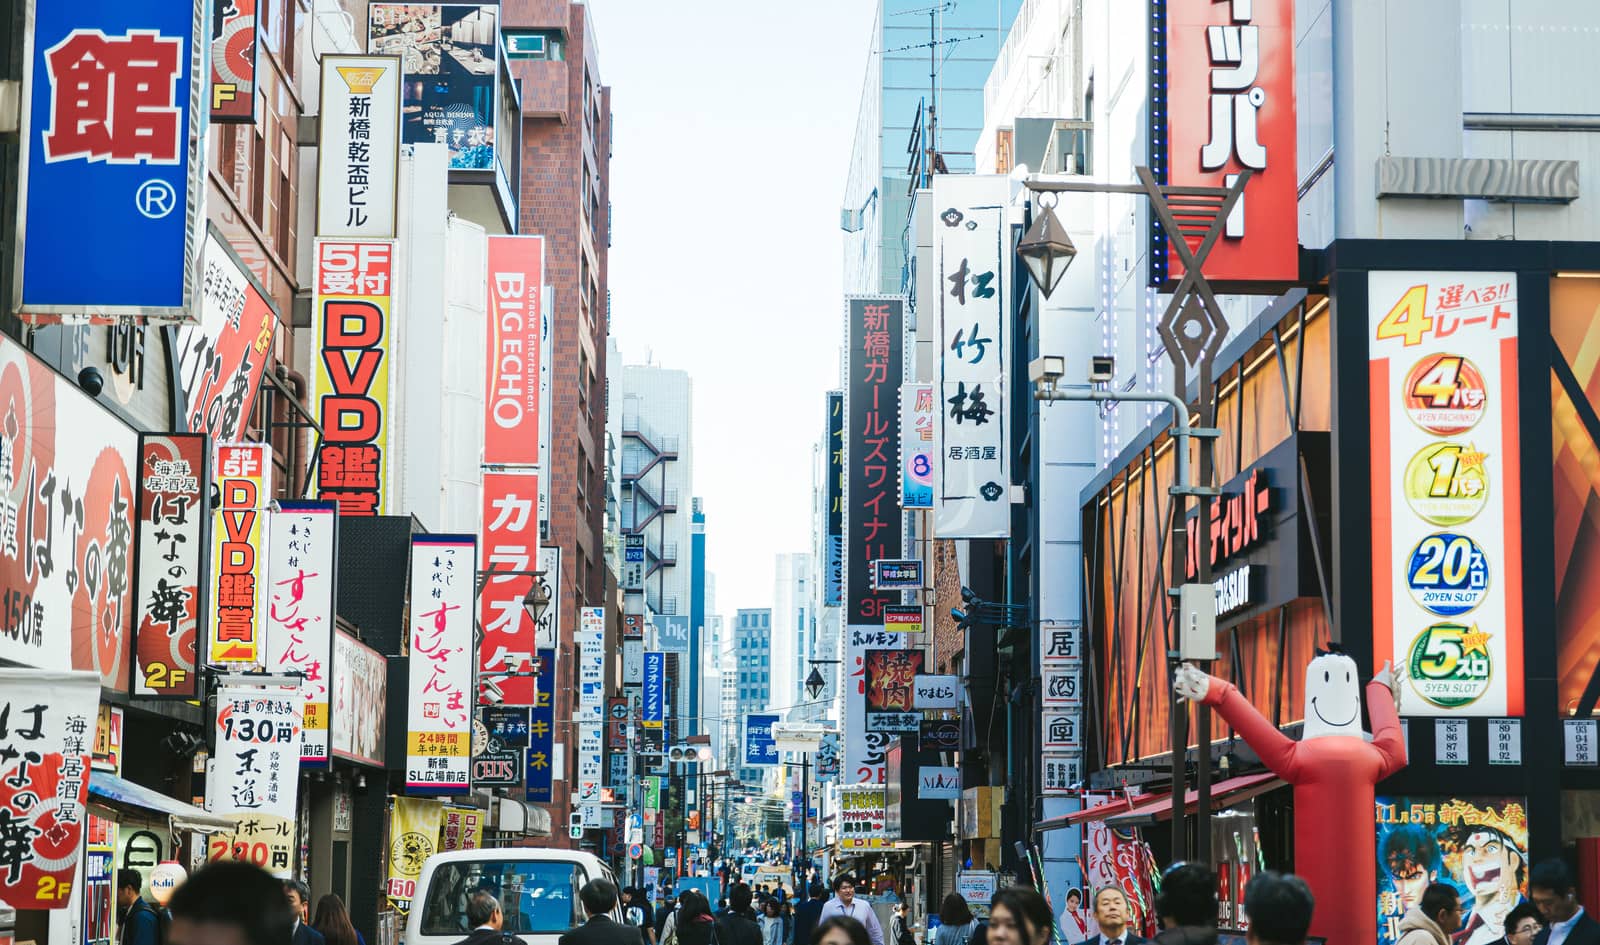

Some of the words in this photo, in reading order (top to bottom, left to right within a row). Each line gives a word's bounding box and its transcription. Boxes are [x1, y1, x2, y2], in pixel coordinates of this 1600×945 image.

[43, 29, 184, 164] 館
[346, 96, 371, 227] 新橋乾盃ビル
[321, 245, 388, 271] 5F
[322, 271, 388, 295] 受付
[494, 272, 525, 333] BIG
[527, 286, 537, 330] Karaoke
[1376, 284, 1433, 347] 4
[1434, 305, 1512, 339] レート
[947, 257, 996, 427] 松竹梅
[493, 338, 524, 429] ECHO
[526, 333, 537, 413] Entertainment
[1452, 388, 1486, 408] パチ
[230, 450, 252, 460] 受付
[948, 446, 998, 461] 居酒屋
[155, 460, 190, 477] 海鮮
[223, 460, 257, 476] 5F
[146, 476, 199, 493] 居酒屋
[1449, 477, 1485, 497] パチ
[147, 495, 192, 637] はなの舞
[218, 479, 257, 642] DVD鑑賞
[1412, 537, 1472, 586] 20
[1470, 552, 1486, 588] スロ
[860, 598, 891, 617] 3F
[1423, 592, 1454, 602] 20YEN
[1455, 592, 1478, 602] SLOT
[3, 587, 44, 648] 150席
[852, 630, 899, 646] ホルモン
[1418, 627, 1468, 678] 5
[1456, 657, 1490, 677] スロ
[144, 662, 186, 689] 2F
[879, 652, 914, 713] 焼肉
[1424, 683, 1449, 693] 5YEN
[1452, 683, 1478, 693] SLOT
[917, 687, 954, 699] やまむら
[225, 719, 293, 743] 130円
[418, 732, 459, 745] 24時間
[416, 744, 460, 755] 年中無休
[55, 715, 87, 823] 海鮮居酒屋
[427, 757, 449, 770] 新橋
[231, 748, 263, 809] 王道
[408, 770, 467, 783] SL広場前店
[1437, 803, 1524, 827] 新台入替
[35, 875, 72, 900] 2F
